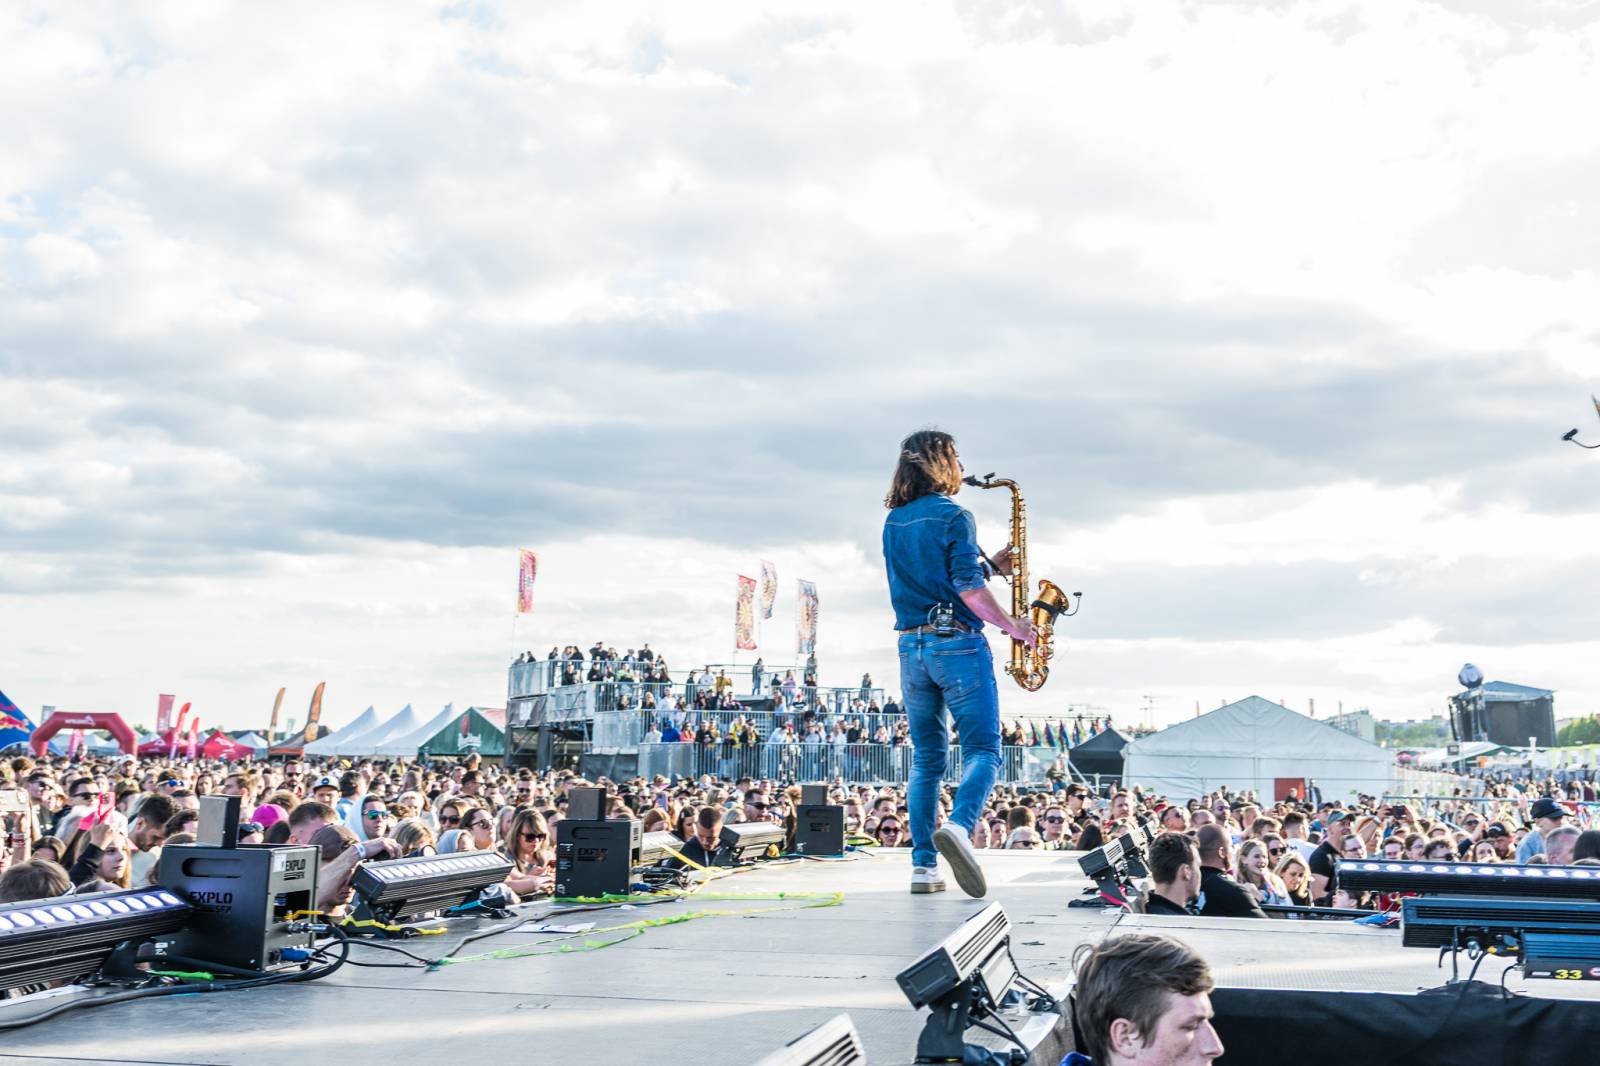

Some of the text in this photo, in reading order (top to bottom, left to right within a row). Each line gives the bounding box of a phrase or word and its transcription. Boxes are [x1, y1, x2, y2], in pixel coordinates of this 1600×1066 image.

[285, 859, 306, 871] EXPLO
[190, 891, 233, 904] EXPLO
[1554, 969, 1583, 980] 33
